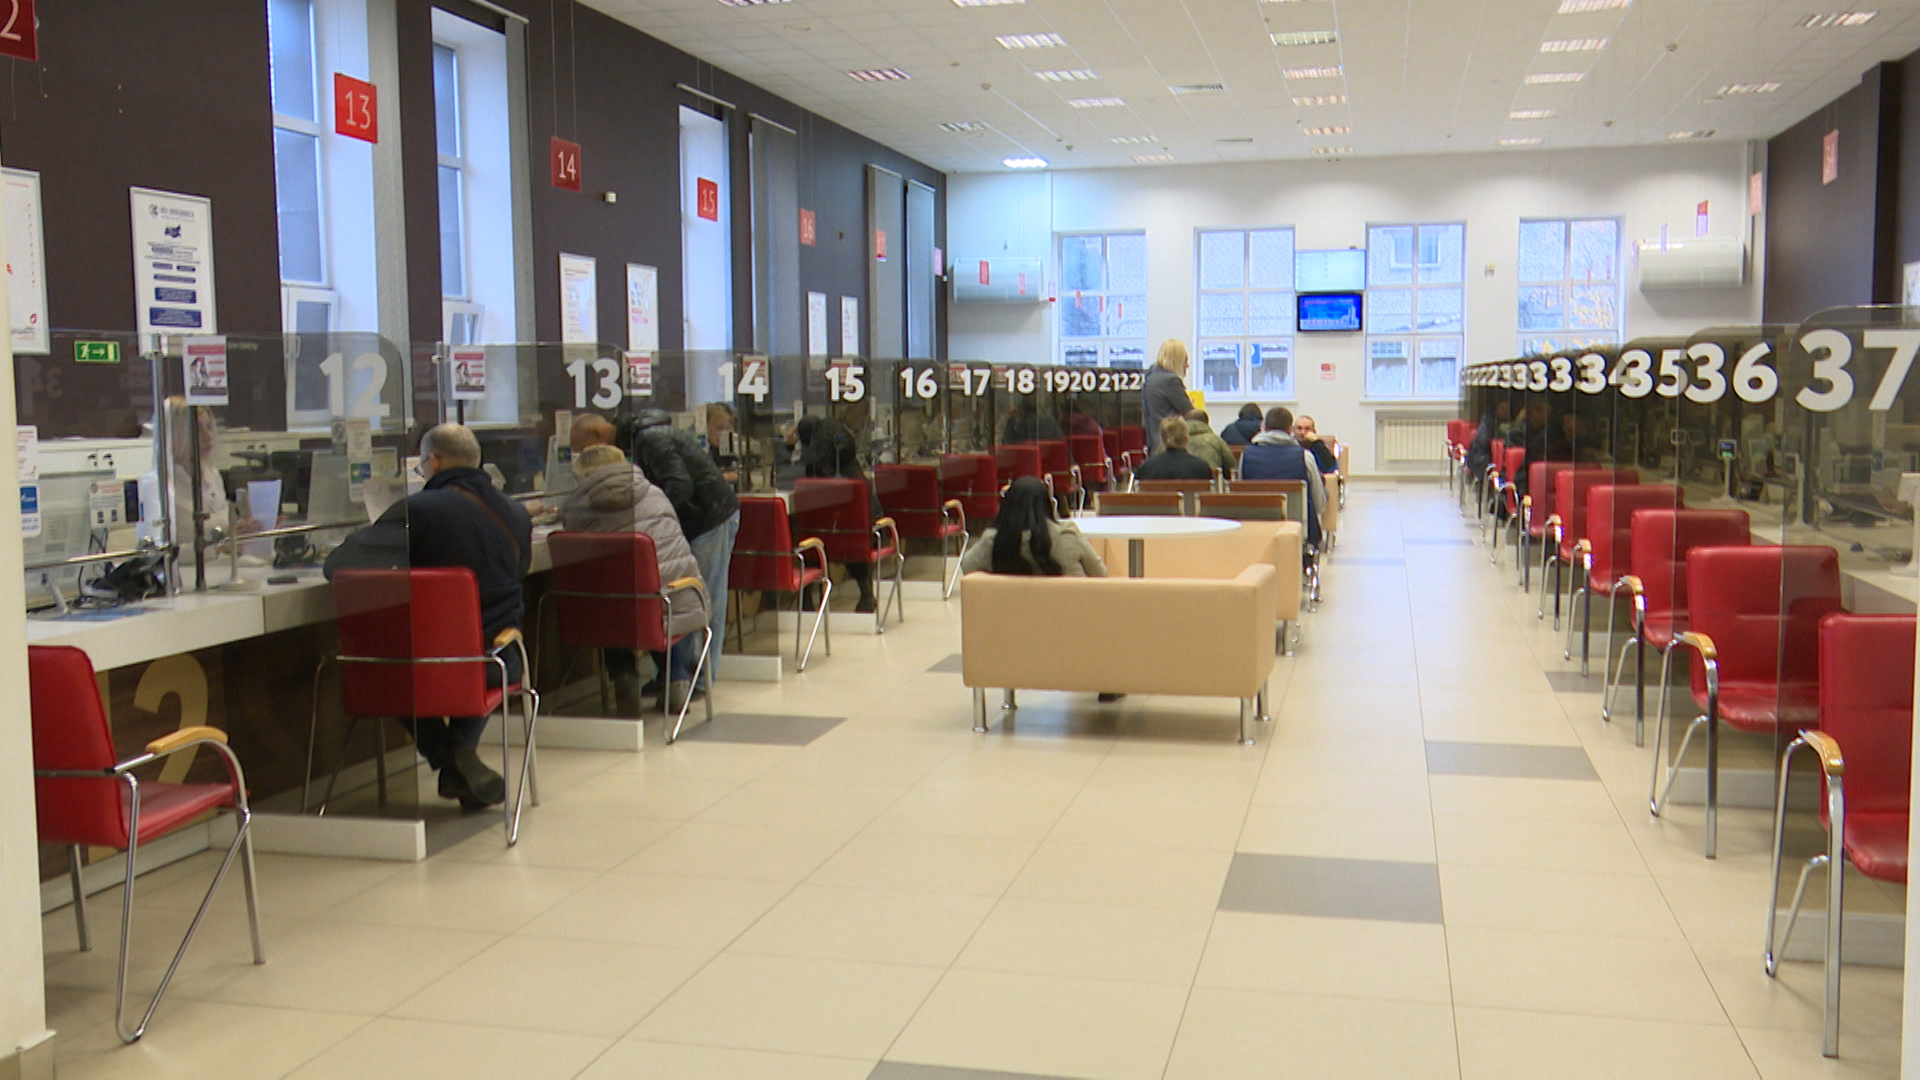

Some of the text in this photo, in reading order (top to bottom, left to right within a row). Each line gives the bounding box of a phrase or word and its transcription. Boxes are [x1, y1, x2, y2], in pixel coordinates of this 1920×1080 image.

[345, 90, 371, 130] 13
[558, 151, 577, 181] 14
[702, 188, 715, 214] 15
[319, 352, 391, 417] 12
[566, 357, 622, 409] 13
[718, 361, 769, 402] 14
[825, 366, 865, 402] 15
[901, 367, 938, 398] 16
[960, 368, 991, 396] 17
[1005, 369, 1035, 394] 18
[1043, 370, 1070, 392] 19
[1070, 371, 1097, 392] 20
[1098, 373, 1120, 392] 21
[1619, 349, 1688, 398] 35
[1683, 342, 1779, 403] 36
[1795, 329, 1920, 412] 37
